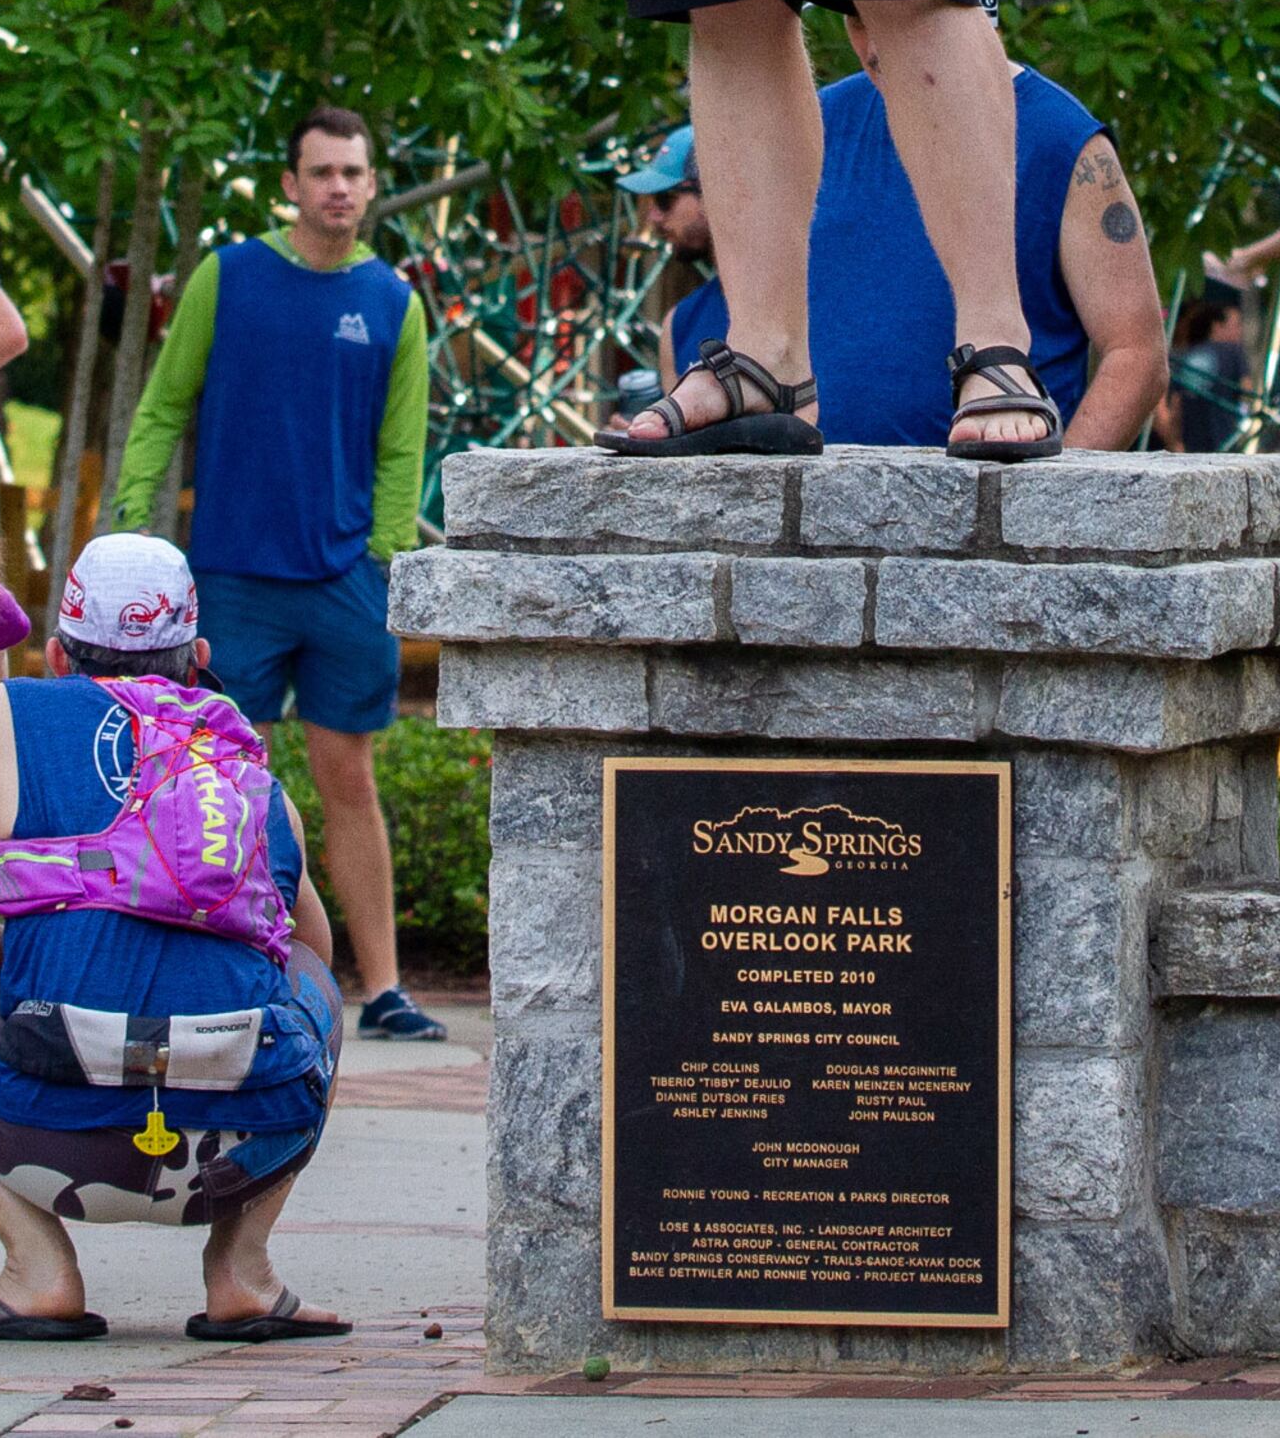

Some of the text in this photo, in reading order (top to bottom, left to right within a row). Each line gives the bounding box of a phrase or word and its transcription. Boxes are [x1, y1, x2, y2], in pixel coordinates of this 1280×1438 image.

[693, 820, 922, 857] SANDY SPRINGS
[835, 860, 910, 871] GEORGIA
[710, 904, 903, 926] MORGAN FALLS
[701, 931, 913, 953] OVERLOOK PARK
[736, 968, 876, 984] COMPLETED 2010
[721, 1000, 892, 1016] EVA GALAMBOS, MAYOR
[712, 1032, 900, 1046] SANDY SPRINGS CITY COUNCIL
[681, 1061, 760, 1074] CHIP COLLINS
[826, 1064, 957, 1077] DOUGLAS MACGINNITIE
[650, 1076, 696, 1088] TIBERIO
[744, 1078, 791, 1090] DEJULIO
[812, 1079, 971, 1092] KAREN MEINZEN MCENERNY
[655, 1091, 786, 1104] DIANNE DUTSON FRIES
[856, 1095, 926, 1107] RUSTY PAUL
[673, 1107, 768, 1119] ASHLEY JENKINS
[848, 1110, 935, 1122] JOHN PAULSON
[751, 1142, 860, 1154] JOHN MCDONOUGH
[763, 1157, 849, 1169] CITY MANAGER
[663, 1188, 706, 1200] RONNIE
[710, 1189, 750, 1201] YOUNG
[762, 1190, 834, 1202] RECREATION
[838, 1192, 846, 1202] &
[850, 1192, 887, 1203] PARKS
[891, 1192, 950, 1204] DIRECTOR
[659, 1221, 689, 1233] LOSE
[693, 1222, 701, 1233] &
[704, 1222, 778, 1235] ASSOCIATES,
[782, 1224, 805, 1235] INC.
[818, 1225, 885, 1236] LANDSCAPE
[888, 1226, 953, 1238] ARCHITECT
[692, 1237, 730, 1248] ASTRA
[732, 1238, 773, 1250] GROUP
[785, 1239, 838, 1251] GENERAL
[841, 1240, 919, 1252] CONTRACTOR
[631, 1251, 669, 1262] SANDY
[673, 1252, 723, 1264] SPRINGS
[726, 1253, 811, 1265] CONSERVANCY
[948, 1257, 981, 1269] DOCK
[629, 1266, 665, 1278] BLAKE
[669, 1267, 733, 1279] DETTWILER
[736, 1268, 760, 1279] AND
[763, 1269, 807, 1281] RONNIE
[810, 1270, 851, 1281] YOUNG
[864, 1271, 916, 1282] PROJECT
[919, 1272, 983, 1284] MANAGERS
